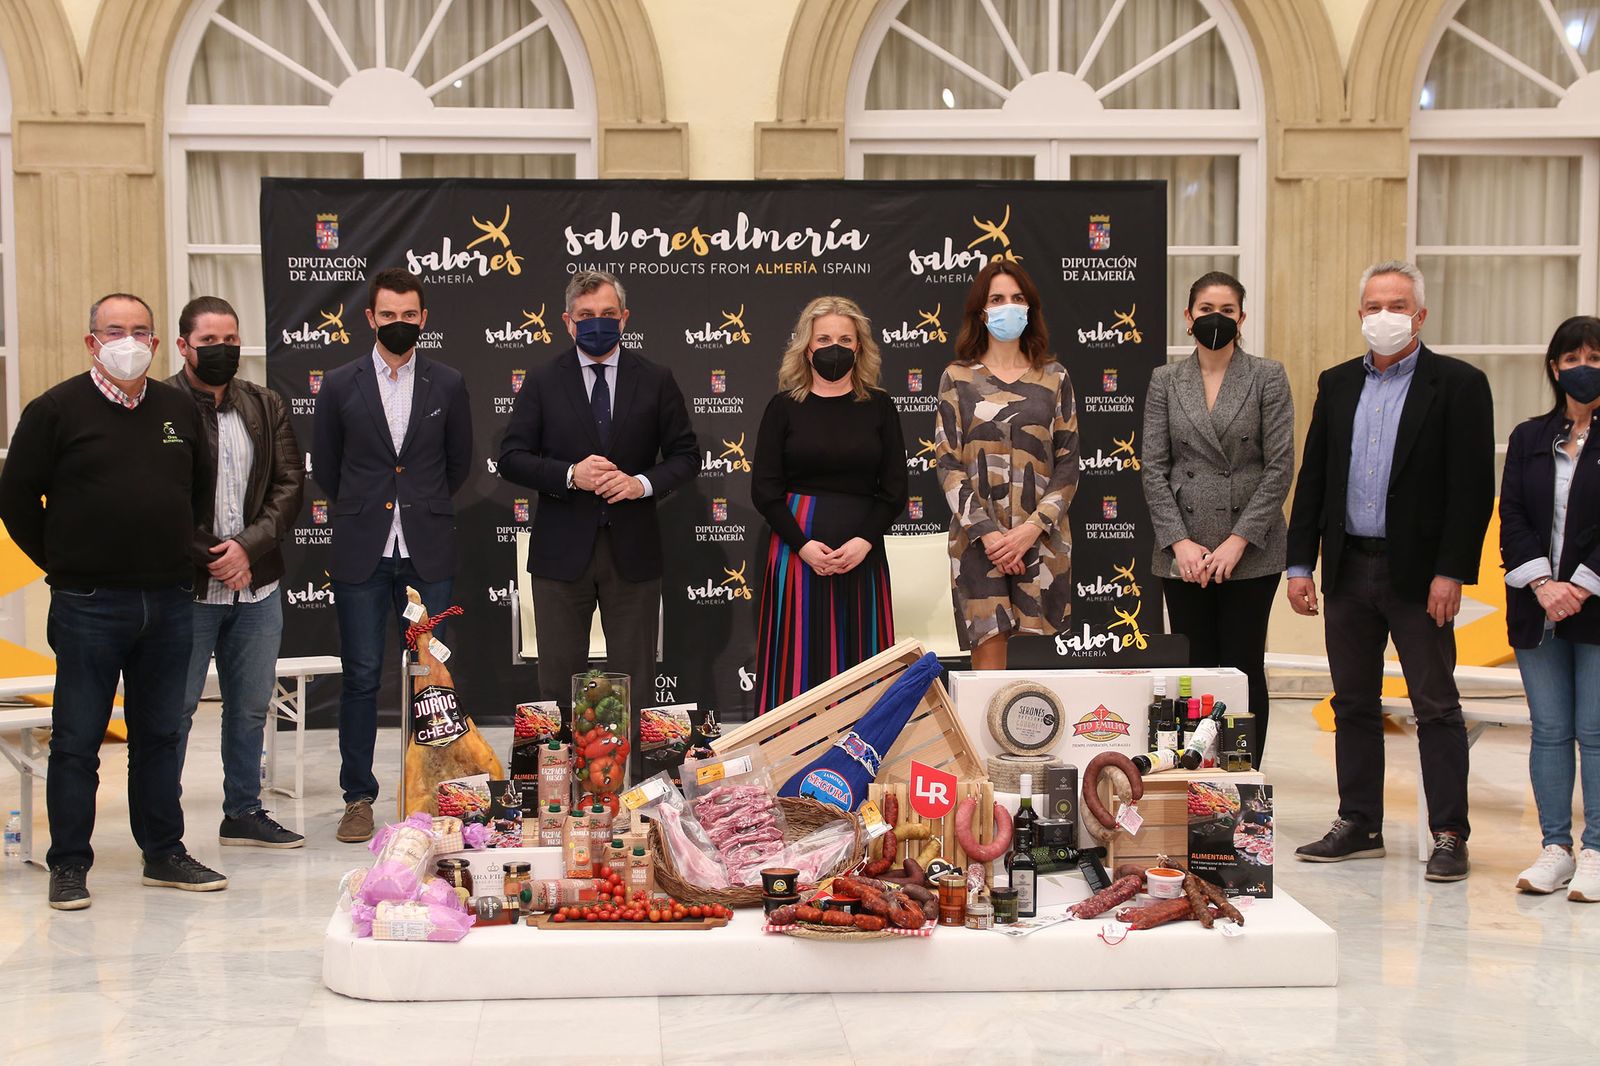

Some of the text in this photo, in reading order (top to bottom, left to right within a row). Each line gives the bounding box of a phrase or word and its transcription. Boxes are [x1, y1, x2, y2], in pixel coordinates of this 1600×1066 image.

[564, 211, 870, 258] saboresalmería
[288, 255, 367, 268] DIPUTACIÓN
[405, 237, 525, 276] sabores
[1061, 255, 1138, 268] DIPUTACIÓN
[565, 260, 871, 276] QUALITY PRODUCTS FROM ALMERÍA (SPAIN)
[289, 268, 366, 282] DE ALMERÍA
[423, 274, 474, 284] ALMERÍA
[924, 273, 975, 283] ALMERÍA
[1063, 268, 1136, 282] DE ALMERÍA
[282, 322, 351, 346] sabores
[485, 321, 553, 345] sabores
[685, 322, 752, 344] sabores
[882, 321, 949, 344] sabores
[1077, 321, 1143, 344] sabores
[693, 396, 744, 406] DIPUTACIÓN
[1085, 395, 1135, 405] DIPUTACIÓN
[293, 406, 305, 415] DE
[495, 406, 507, 414] DE
[695, 403, 743, 414] DE ALMERÍA
[1086, 402, 1134, 412] DE ALMERÍA
[1079, 449, 1142, 472] sabores
[1086, 468, 1115, 476] ALMERÍA
[695, 524, 746, 535] DIPUTACIÓN
[891, 522, 941, 532] DIPUTACIÓN
[1085, 522, 1136, 532] DIPUTACIÓN
[295, 536, 307, 545] DE
[497, 534, 509, 543] DE
[696, 531, 745, 542] DE ALMERÍA
[1087, 529, 1135, 540] DE ALMERÍA
[687, 578, 753, 600] sabores
[1077, 576, 1142, 599] sabores
[1054, 623, 1150, 657] sabores
[1071, 648, 1108, 657] ALMERÍA
[418, 721, 464, 741] CHECA
[823, 772, 844, 787] JAMONES
[807, 773, 849, 805] SEGURA
[915, 775, 950, 805] LR
[1191, 853, 1235, 861] ALIMENTARIA
